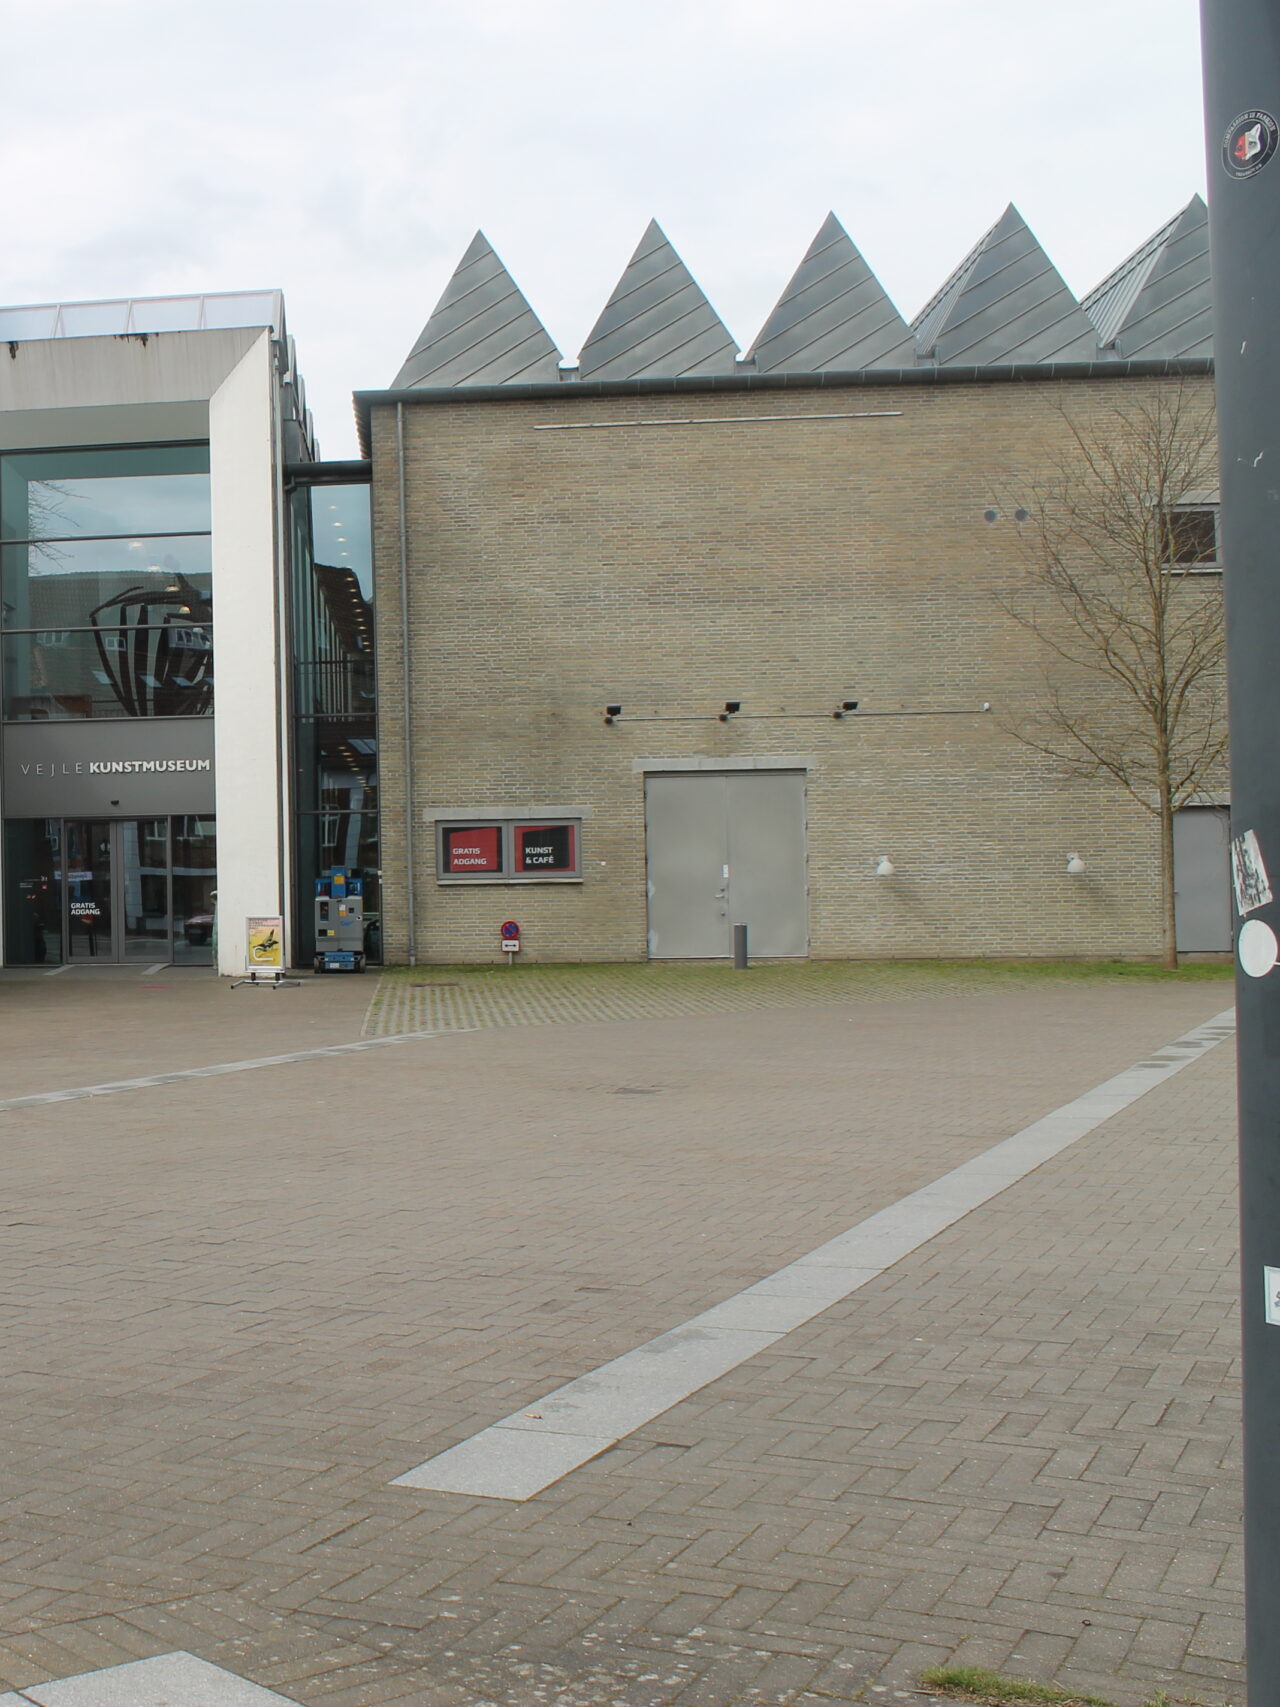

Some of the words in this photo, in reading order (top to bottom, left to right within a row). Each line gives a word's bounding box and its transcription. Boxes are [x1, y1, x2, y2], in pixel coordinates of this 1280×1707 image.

[20, 762, 83, 777] VEJLE
[89, 759, 211, 775] KUNSTMUSEUM
[452, 847, 481, 855] GRATIS
[453, 857, 487, 865] ADGANG
[532, 855, 554, 864] CAFÉ
